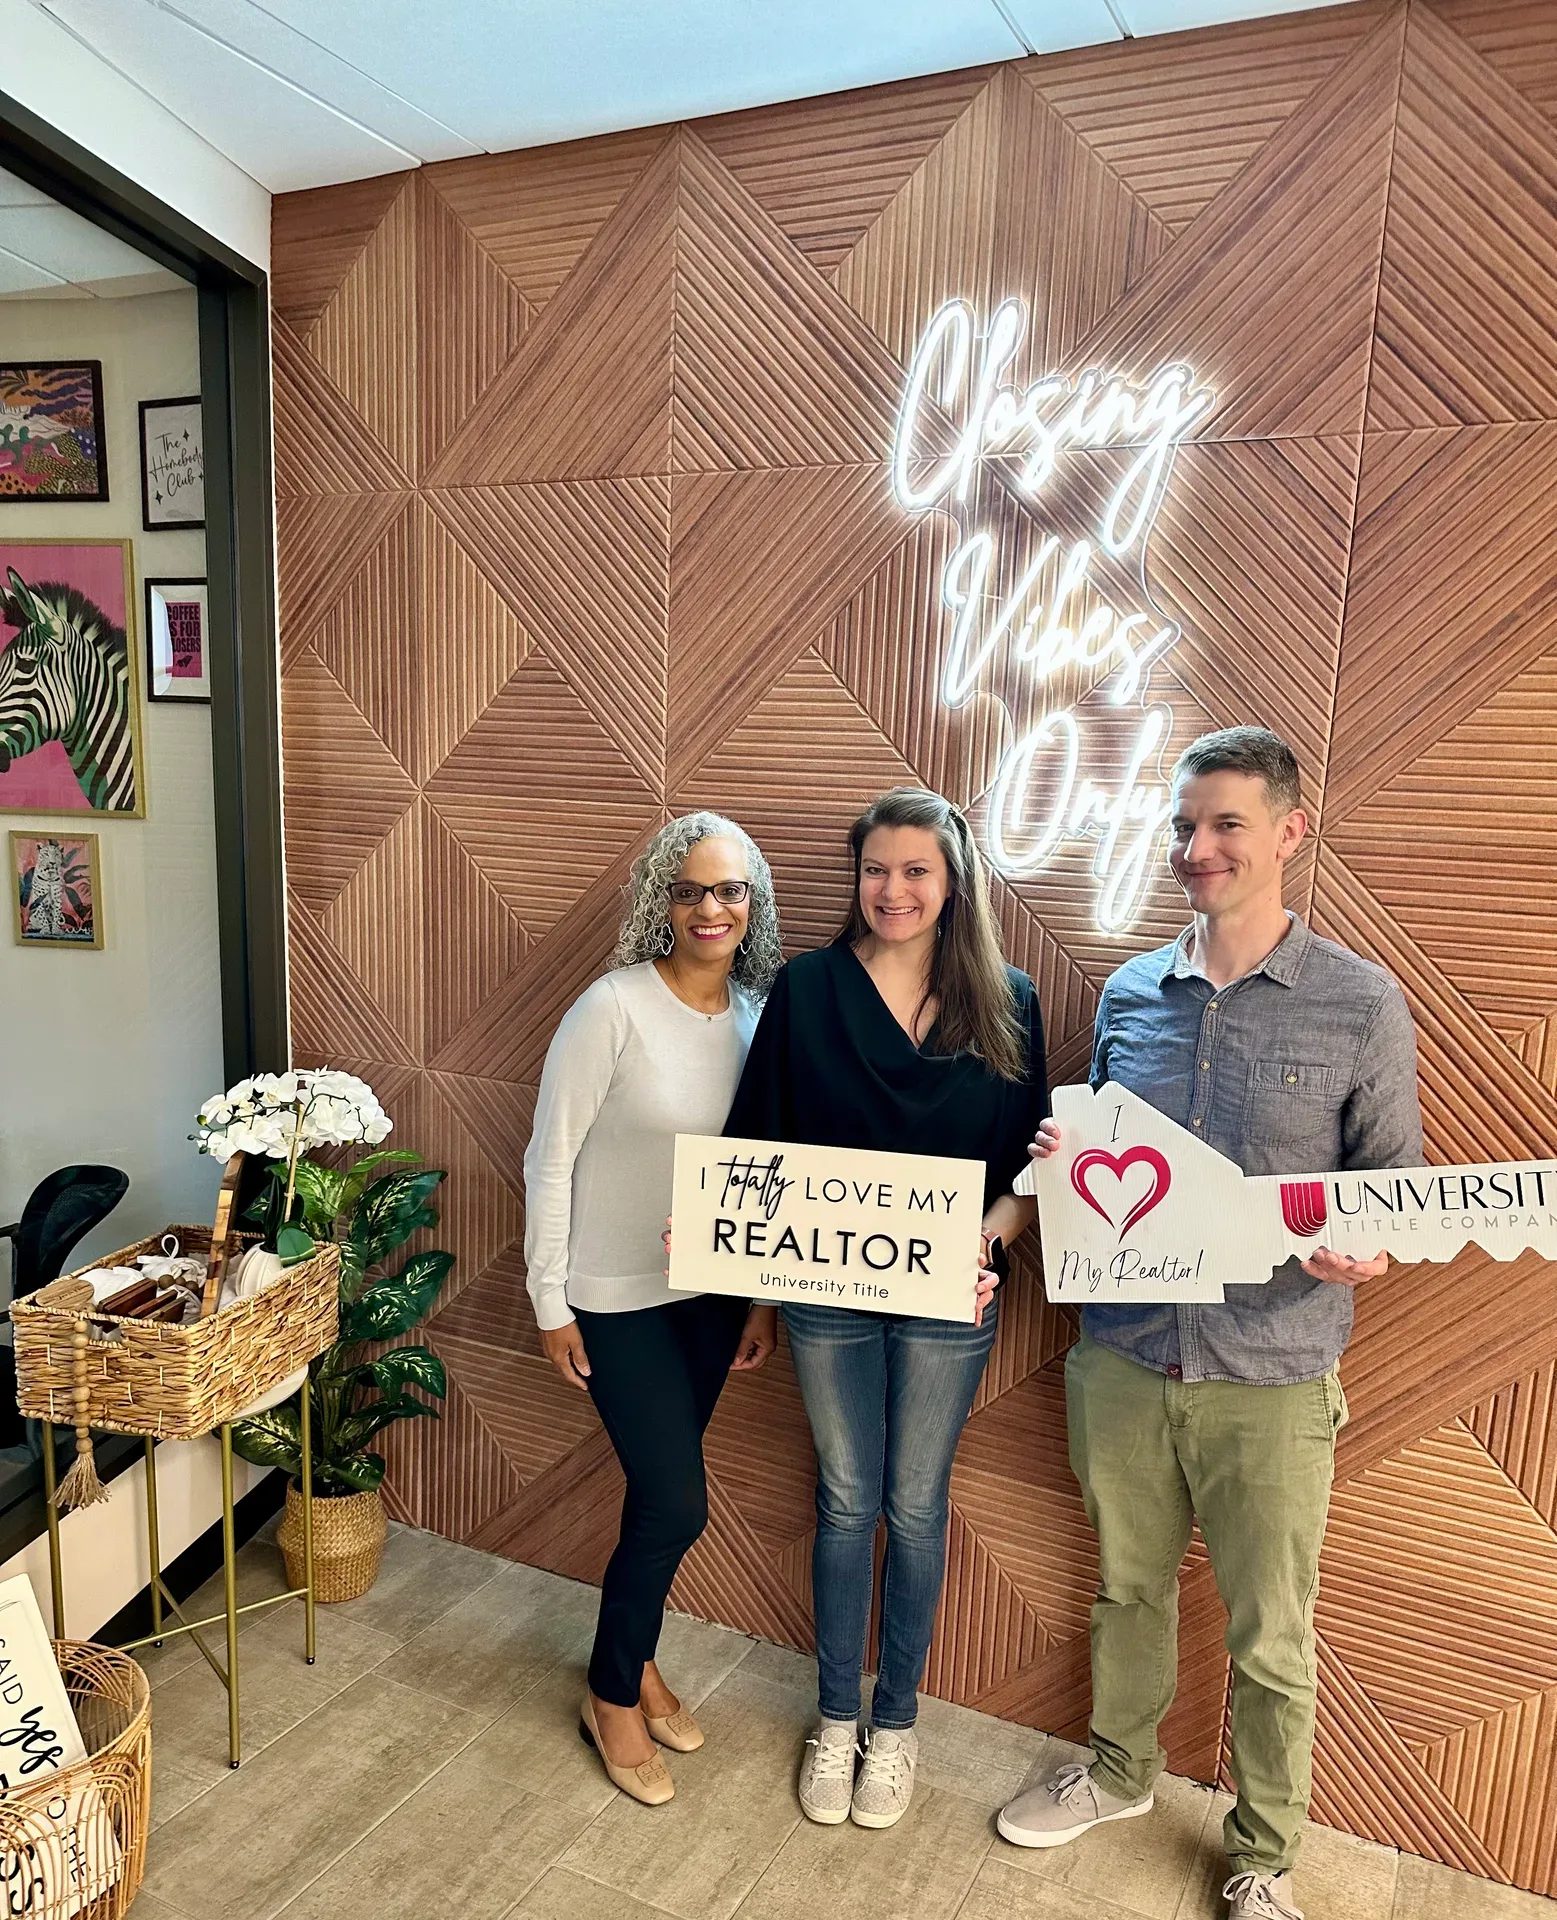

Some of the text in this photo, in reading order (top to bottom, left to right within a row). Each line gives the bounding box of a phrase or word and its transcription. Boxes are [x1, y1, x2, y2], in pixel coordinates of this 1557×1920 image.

[155, 432, 181, 459] The
[898, 301, 1208, 556] Closing
[149, 445, 204, 483] Homebody
[167, 467, 196, 497] Club
[167, 605, 200, 620] COFFEE
[169, 621, 201, 637] S FOR
[946, 532, 1172, 706] Vibes
[171, 637, 201, 653] LOSERS
[991, 709, 1173, 929] Only
[1110, 1103, 1125, 1143] I
[700, 1166, 706, 1190] I
[805, 1176, 893, 1208] LOVE
[907, 1187, 958, 1214] MY
[1334, 1170, 1557, 1216] UNIVERSIT
[1343, 1218, 1419, 1233] TITLE
[713, 1217, 932, 1275] REALTOR
[759, 1272, 889, 1299] University Title
[1058, 1248, 1204, 1293] My Realtor!
[0, 1705, 64, 1775] yes
